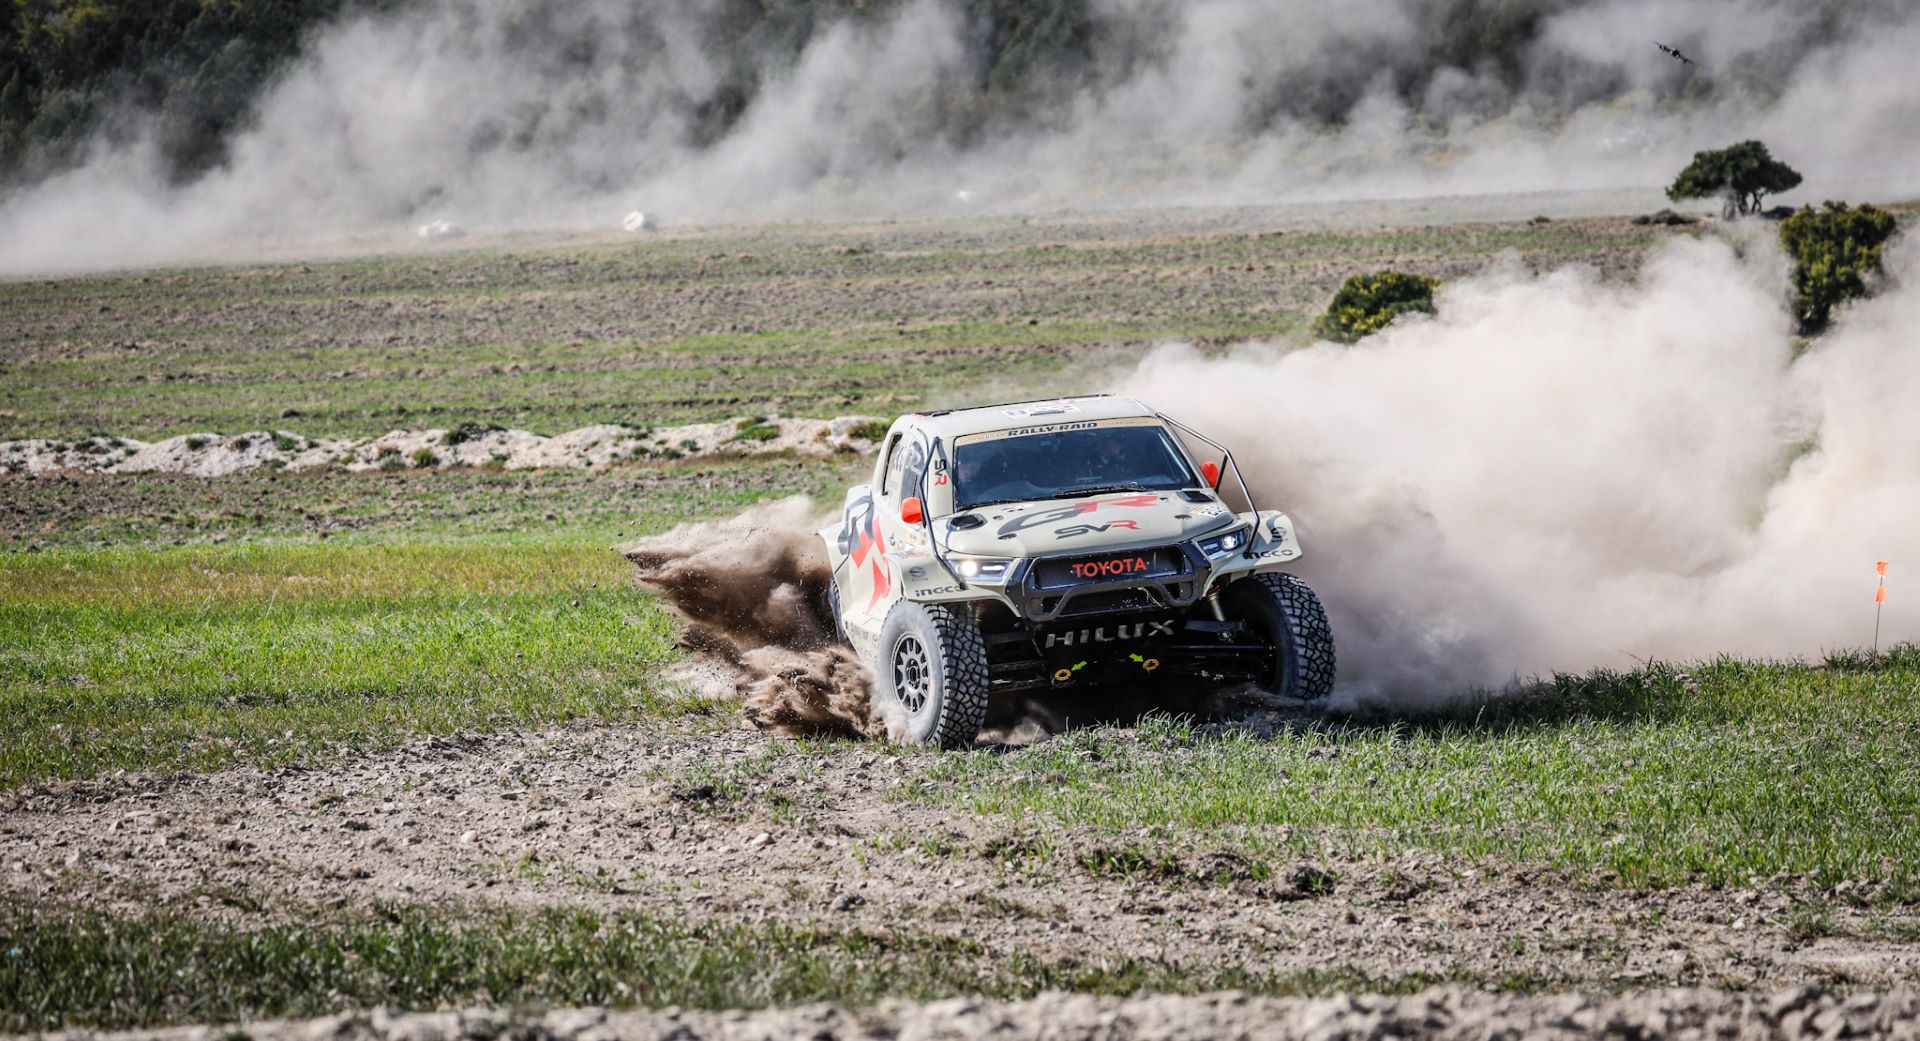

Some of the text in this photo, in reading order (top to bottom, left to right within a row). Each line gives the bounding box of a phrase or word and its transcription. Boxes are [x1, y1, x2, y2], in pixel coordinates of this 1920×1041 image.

[1054, 520, 1141, 540] SVR
[1072, 557, 1147, 577] TOYOTA
[1045, 619, 1174, 648] HILUX
